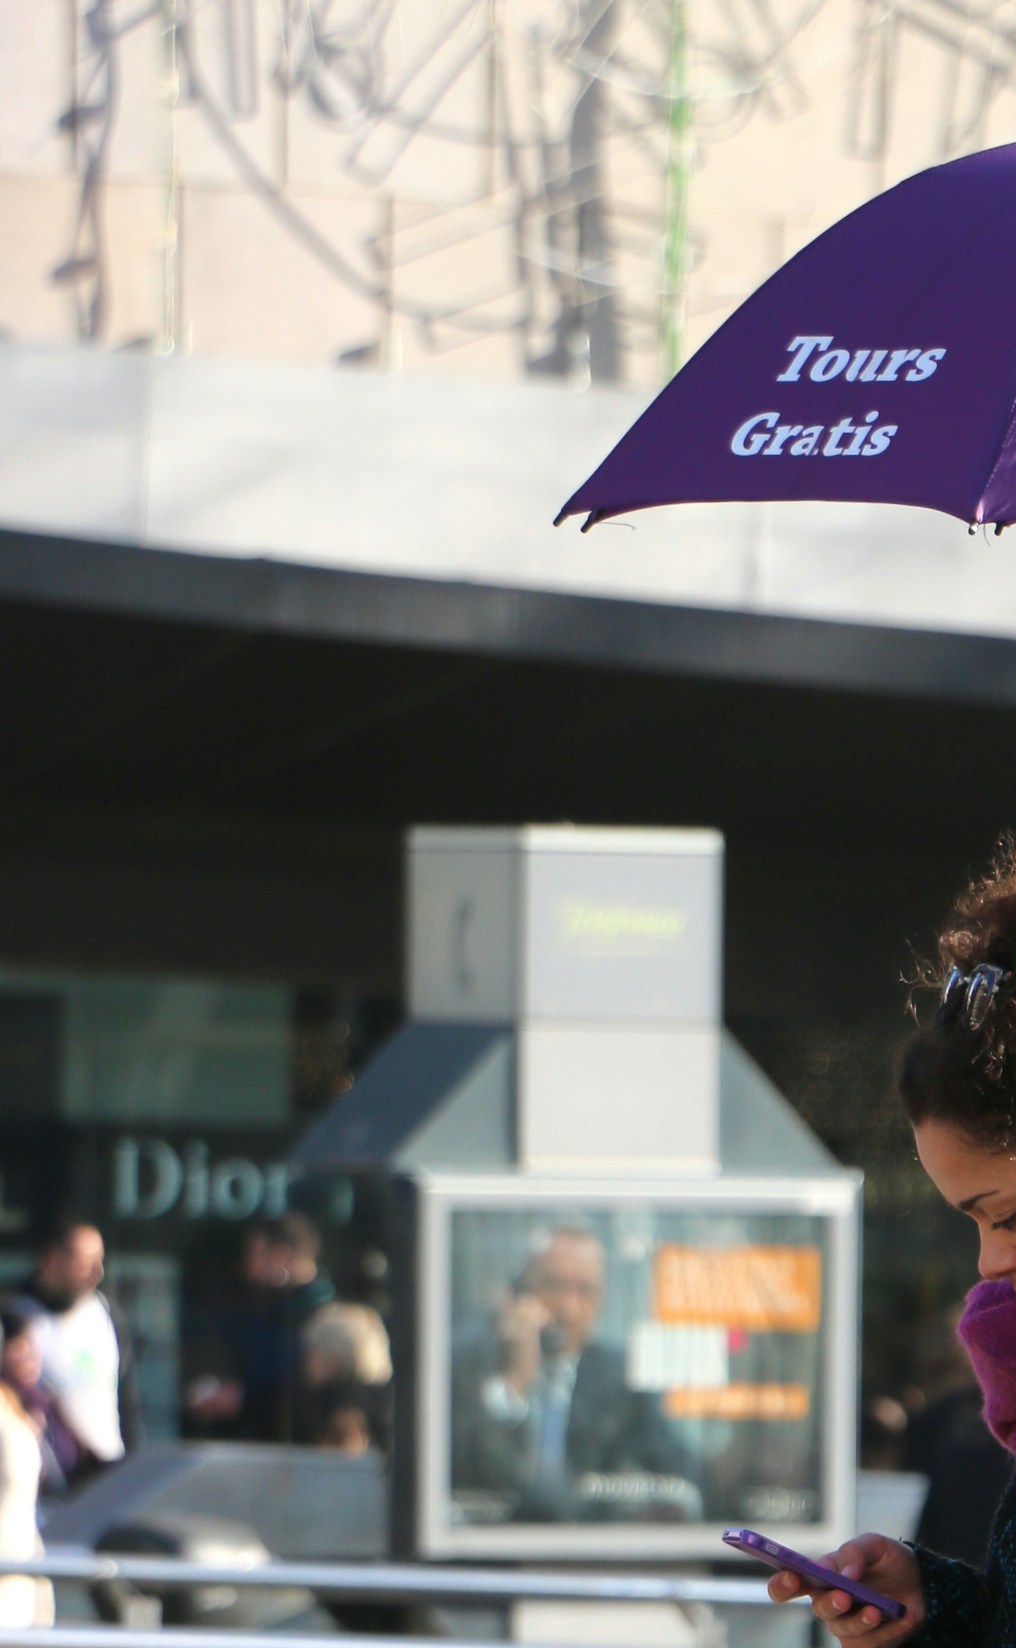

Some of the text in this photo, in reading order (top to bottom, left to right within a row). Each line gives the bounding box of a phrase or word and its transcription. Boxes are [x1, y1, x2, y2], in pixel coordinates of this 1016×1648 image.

[776, 336, 947, 382] Tours
[730, 411, 898, 456] Gratis
[113, 1136, 290, 1219] Dior
